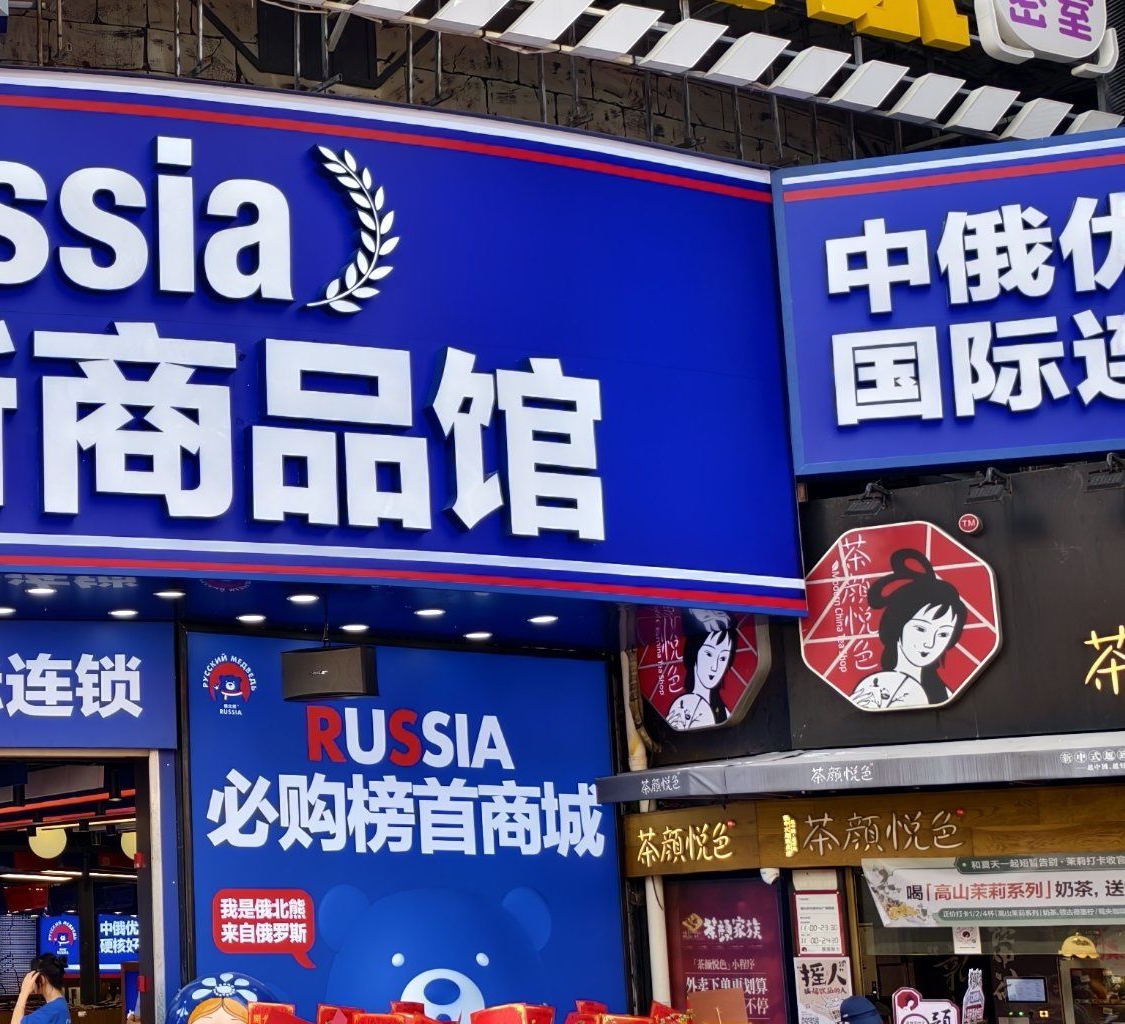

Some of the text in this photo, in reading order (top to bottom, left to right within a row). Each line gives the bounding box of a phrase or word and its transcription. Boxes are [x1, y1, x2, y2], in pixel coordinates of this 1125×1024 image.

[202, 653, 257, 691] РУССКИЙ МЕДВЕДЬ
[1084, 624, 1125, 695] 茶
[219, 708, 242, 716] RUSSIA
[306, 704, 515, 770] RUSSIA
[205, 768, 606, 857] 必购榜首商城
[220, 898, 306, 920] 我是俄北熊
[100, 920, 139, 936] 中俄优
[221, 922, 307, 944] 来自俄罗斯
